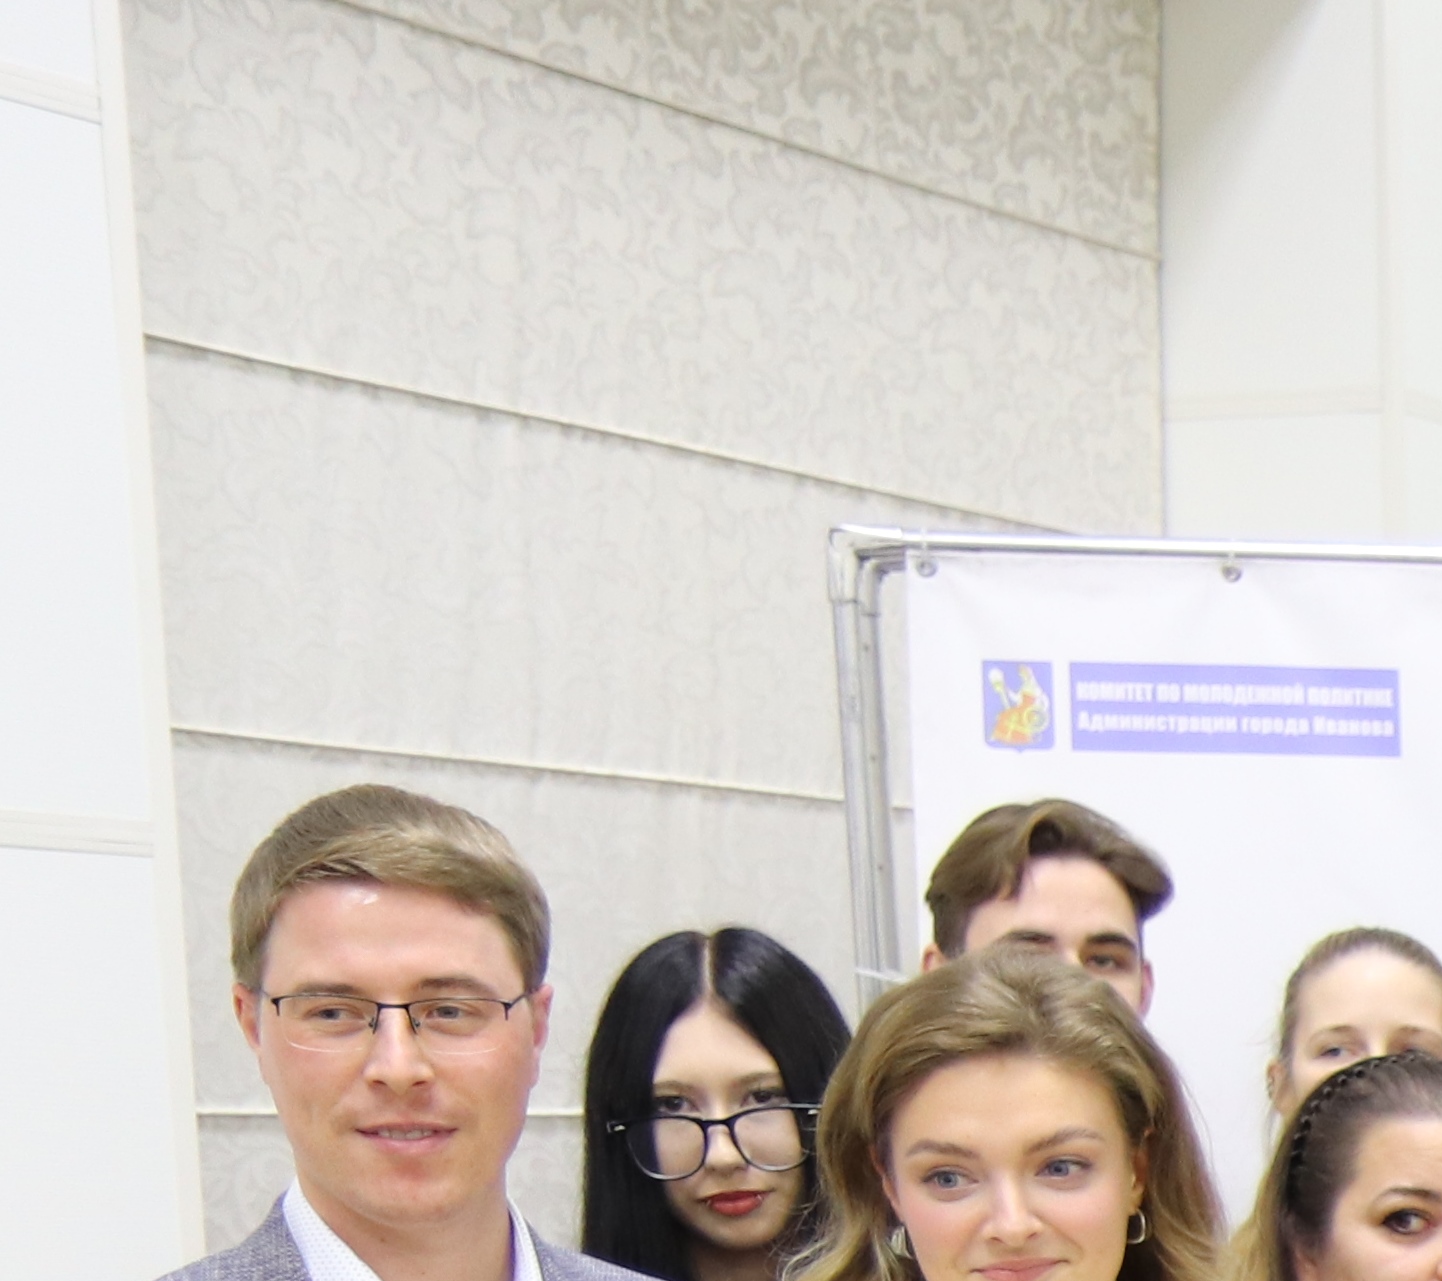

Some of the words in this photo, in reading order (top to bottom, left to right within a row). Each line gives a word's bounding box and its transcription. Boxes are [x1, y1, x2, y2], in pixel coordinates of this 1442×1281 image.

[1075, 681, 1154, 703] КОМИТЕТ
[1156, 683, 1181, 703] ПО
[1182, 682, 1305, 706] МОЛОДЕЖНОЙ
[1307, 687, 1394, 708] ПОЛИТИКЕ
[1077, 711, 1238, 735] Администрации
[1241, 716, 1310, 737] города
[1313, 715, 1394, 737] Иванова
